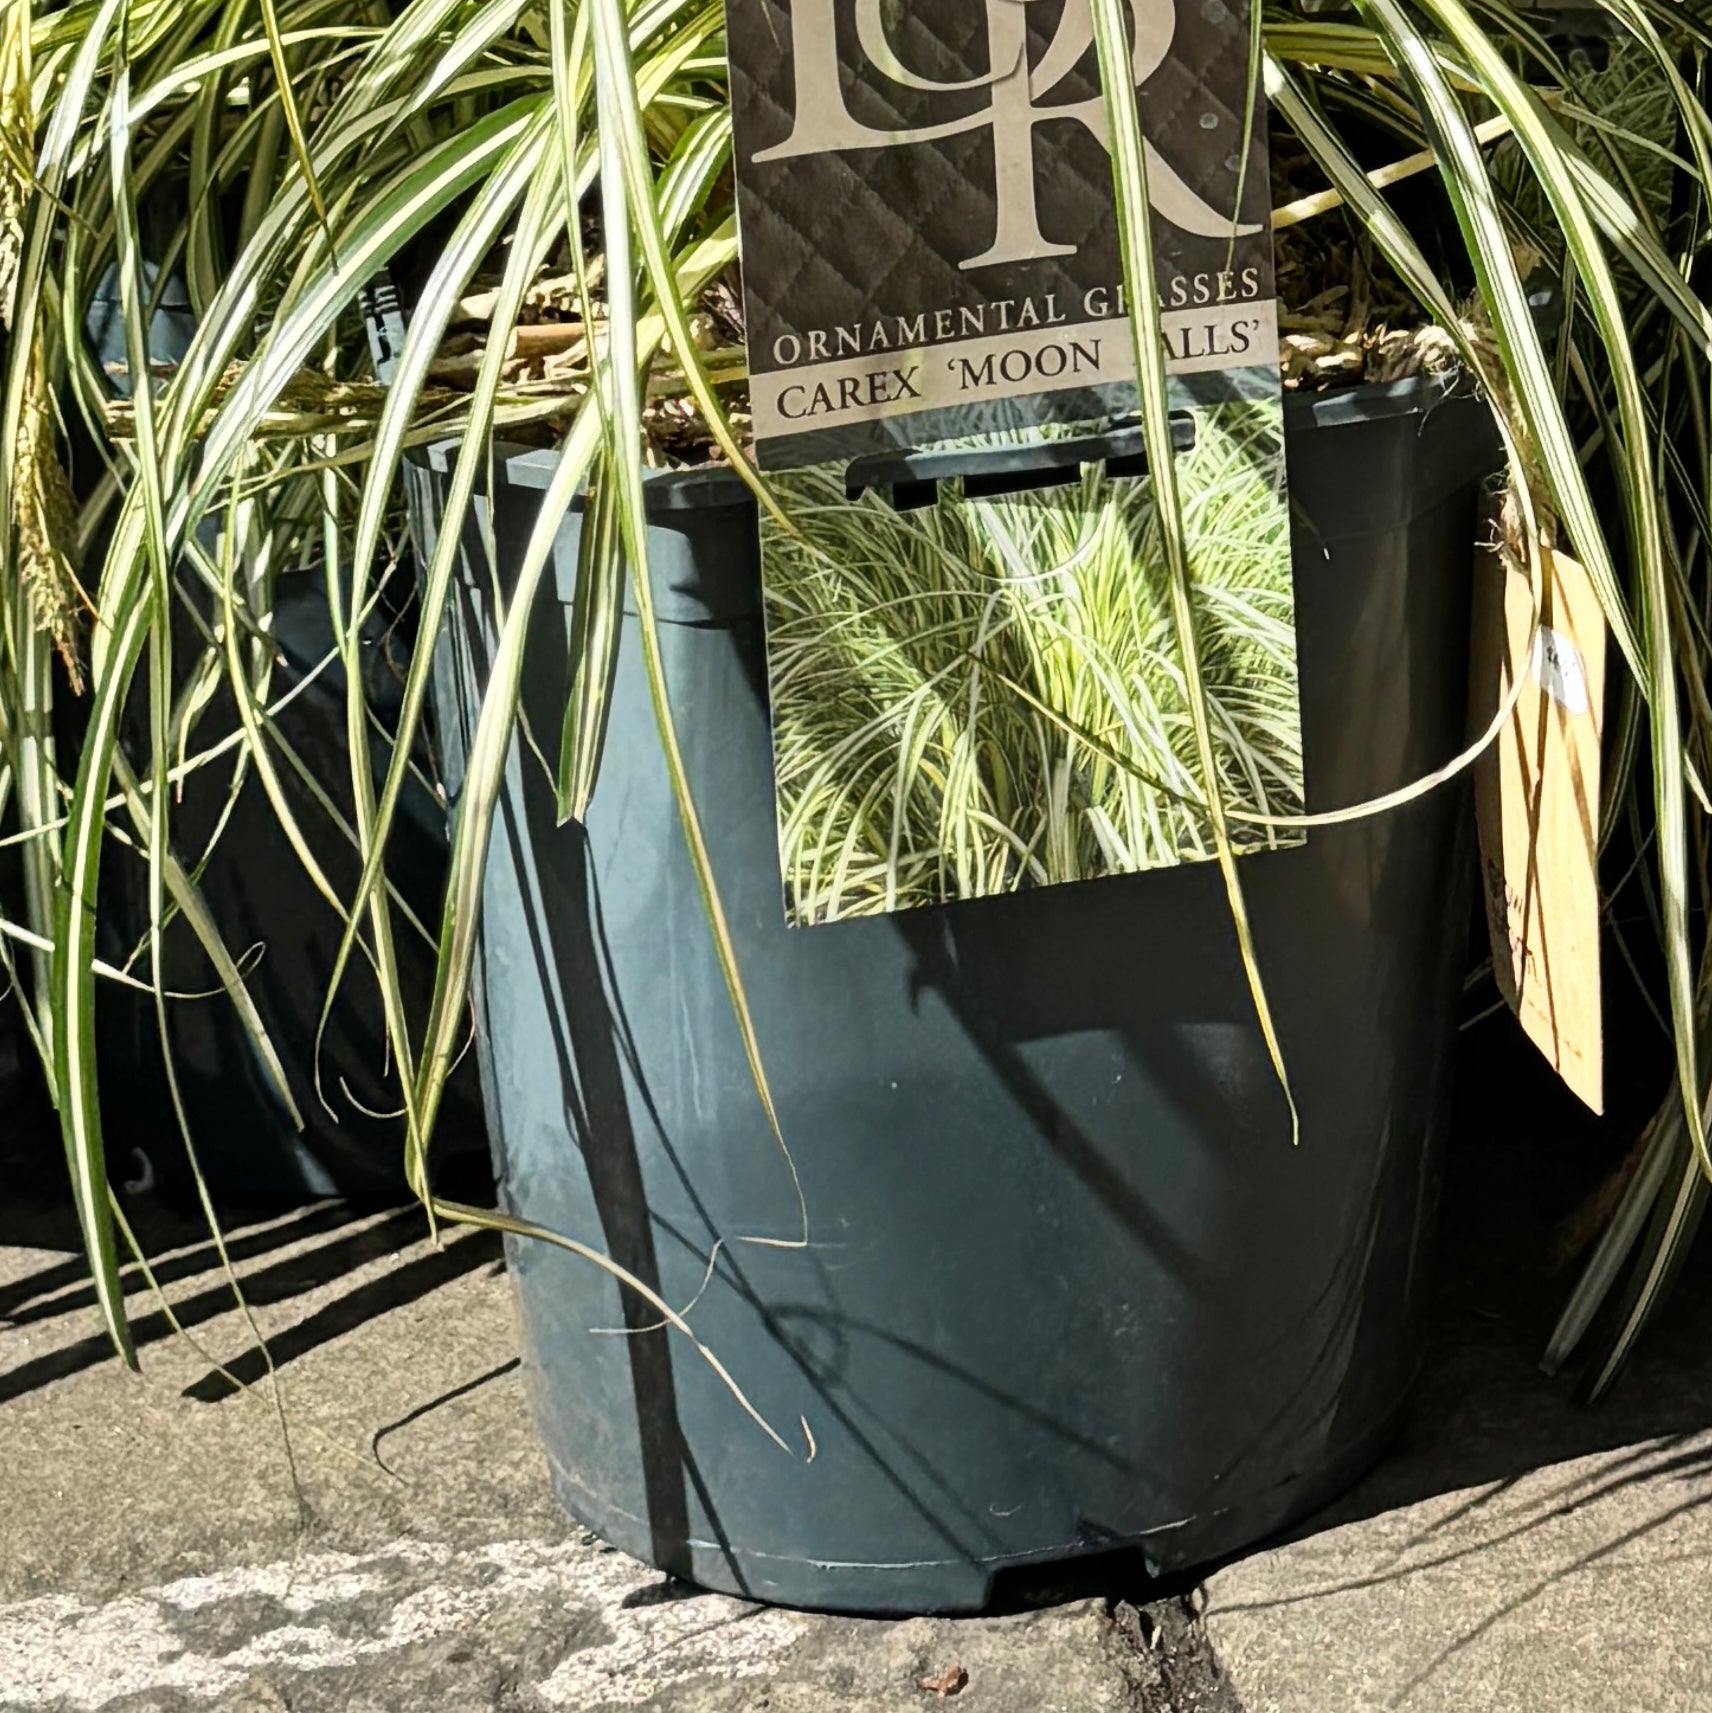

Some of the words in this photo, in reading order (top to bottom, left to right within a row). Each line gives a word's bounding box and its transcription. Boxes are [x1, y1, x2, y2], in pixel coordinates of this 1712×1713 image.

[772, 293, 1067, 365] ORNAMENTAL
[1083, 267, 1259, 317] GSSES
[775, 365, 922, 420] CAREX
